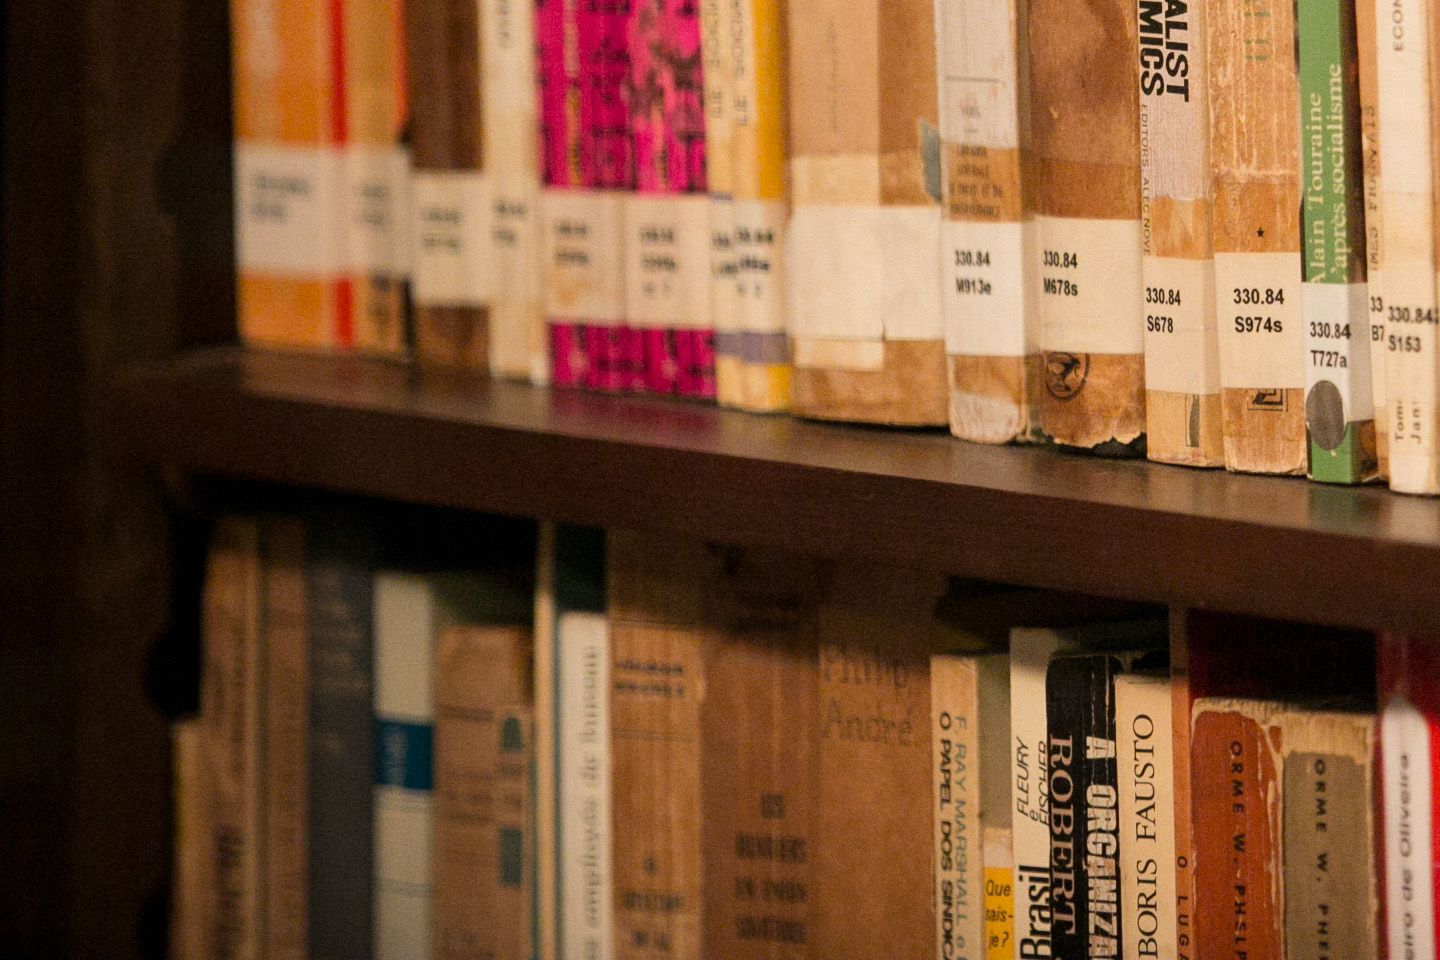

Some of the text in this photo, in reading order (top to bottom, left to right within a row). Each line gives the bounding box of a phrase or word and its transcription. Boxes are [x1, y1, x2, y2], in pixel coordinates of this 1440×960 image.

[1326, 63, 1347, 197] socialisme
[1308, 92, 1325, 210] Touraine
[1142, 177, 1150, 214] ALEC
[1142, 218, 1152, 257] NOVE
[953, 249, 990, 268] 330.84
[1042, 249, 1078, 269] 330.84
[955, 279, 992, 296] M913e
[1042, 279, 1079, 298] M678s
[1145, 287, 1181, 307] 330.84
[1232, 287, 1285, 306] 330.84
[1146, 315, 1174, 333] S678
[1234, 316, 1284, 334] S974s
[1309, 321, 1352, 340] 330.84
[1310, 350, 1348, 369] T727a
[940, 711, 951, 729] O
[1086, 735, 1116, 760] A
[940, 739, 952, 811] PAPEL
[954, 743, 966, 792] RAY
[1015, 735, 1030, 821] FLEURY
[1229, 741, 1246, 814] ORME
[1314, 758, 1328, 833] ORME
[1399, 753, 1412, 858] Oliveira
[1029, 808, 1039, 821] e
[941, 820, 953, 873] DOS
[1050, 733, 1076, 936] ROBERT
[1132, 713, 1158, 960] BORIS FAUSTO
[1233, 834, 1246, 864] W.
[955, 799, 968, 924] MARSHALL
[1177, 855, 1188, 869] O
[1316, 853, 1329, 883] W.
[985, 879, 1011, 897] Que
[1401, 868, 1413, 901] de
[984, 906, 1013, 923] sais-
[1018, 864, 1051, 960] Brasil
[988, 932, 1010, 951] je?
